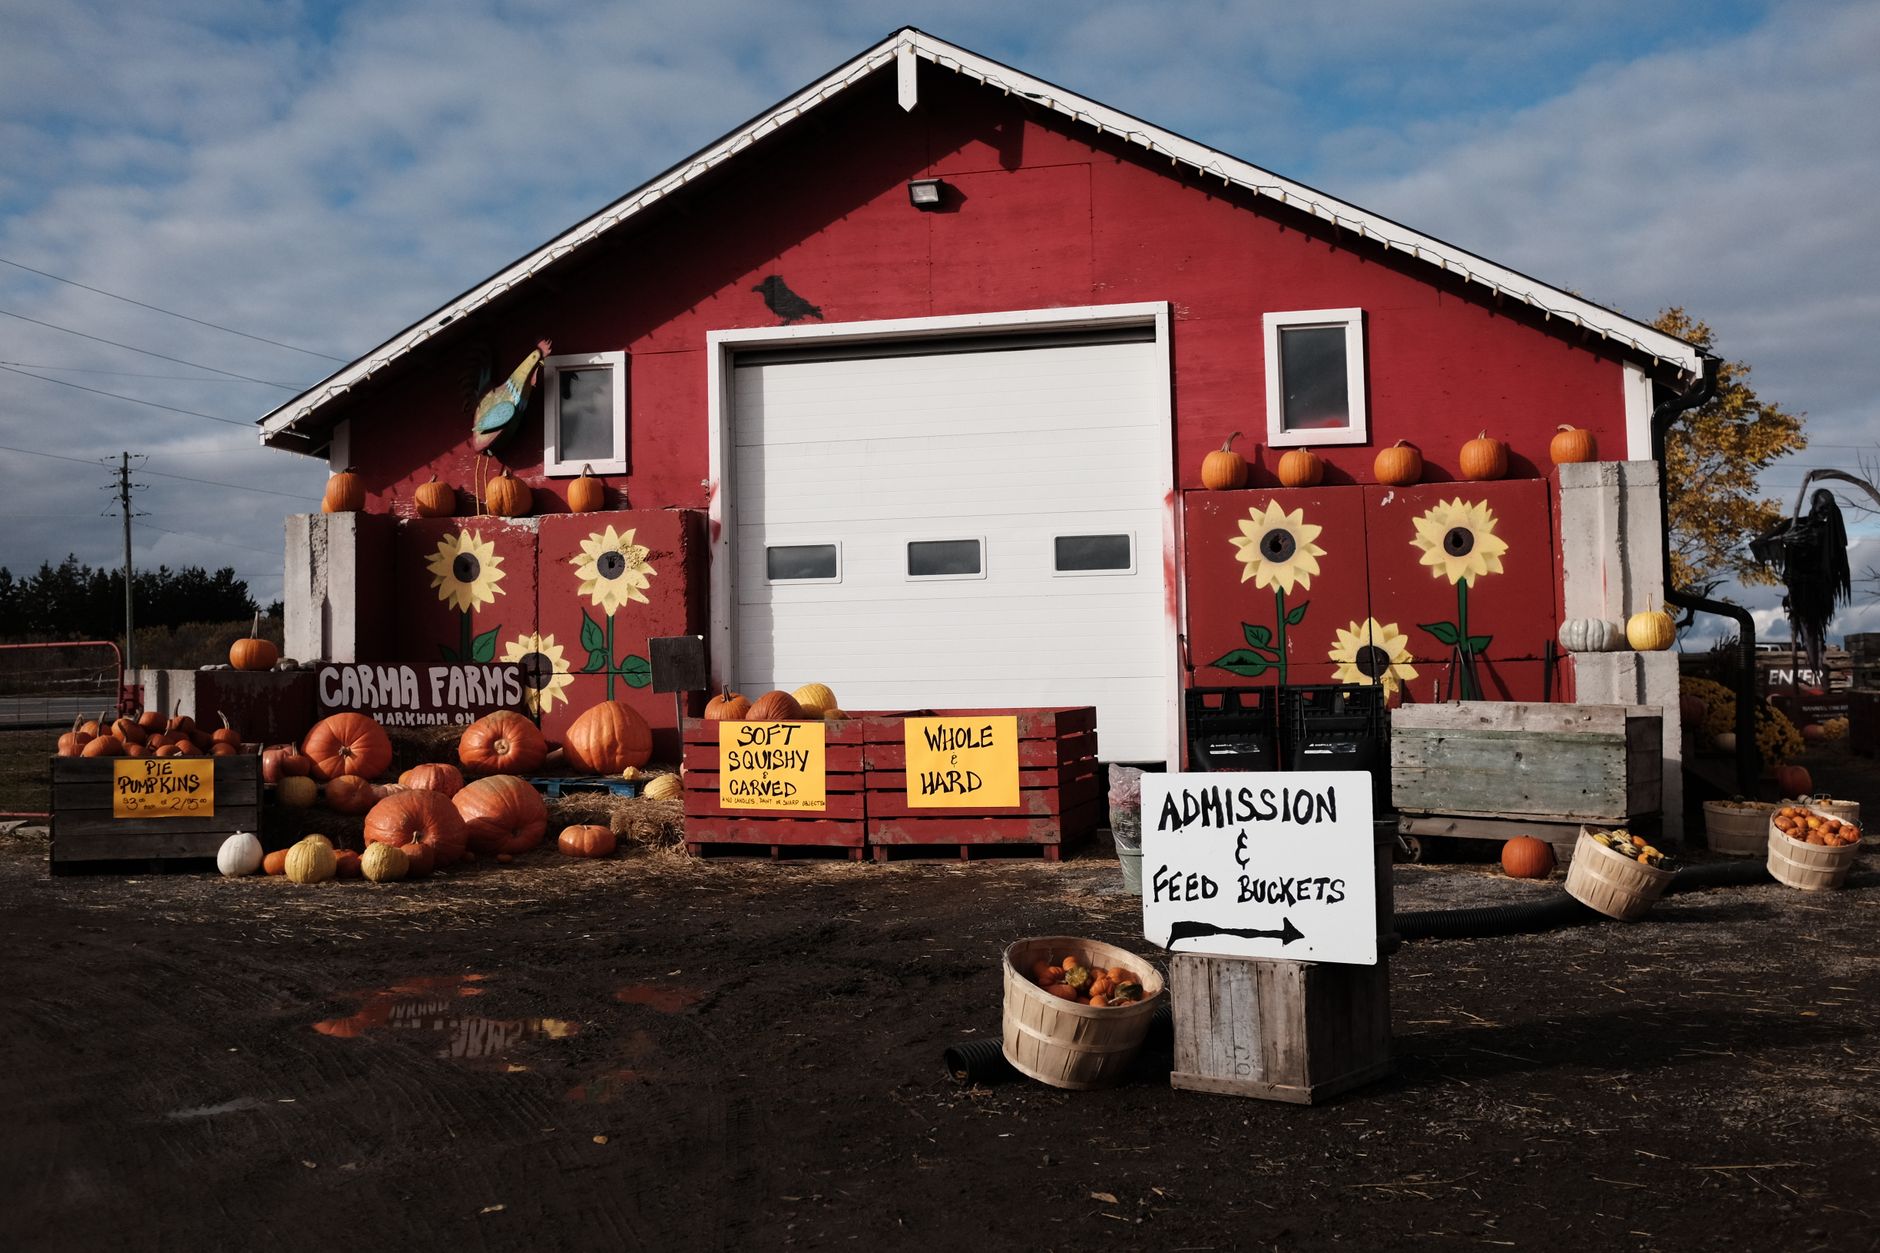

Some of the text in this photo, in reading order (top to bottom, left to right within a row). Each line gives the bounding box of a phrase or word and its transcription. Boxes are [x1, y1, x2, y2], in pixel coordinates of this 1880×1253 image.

[319, 664, 523, 710] CARMA FARMS
[455, 712, 475, 726] ON
[737, 723, 801, 747] SOFT
[924, 724, 993, 752] WHOLE
[145, 760, 172, 776] PIE
[728, 749, 809, 772] SQUISHY
[117, 774, 200, 795] PUMPKINS
[729, 779, 797, 797] CARVED
[920, 770, 982, 795] HARD
[1158, 785, 1337, 832] ADMISSION
[1235, 828, 1250, 871] &
[1153, 864, 1345, 907] FEED BUCKETS
